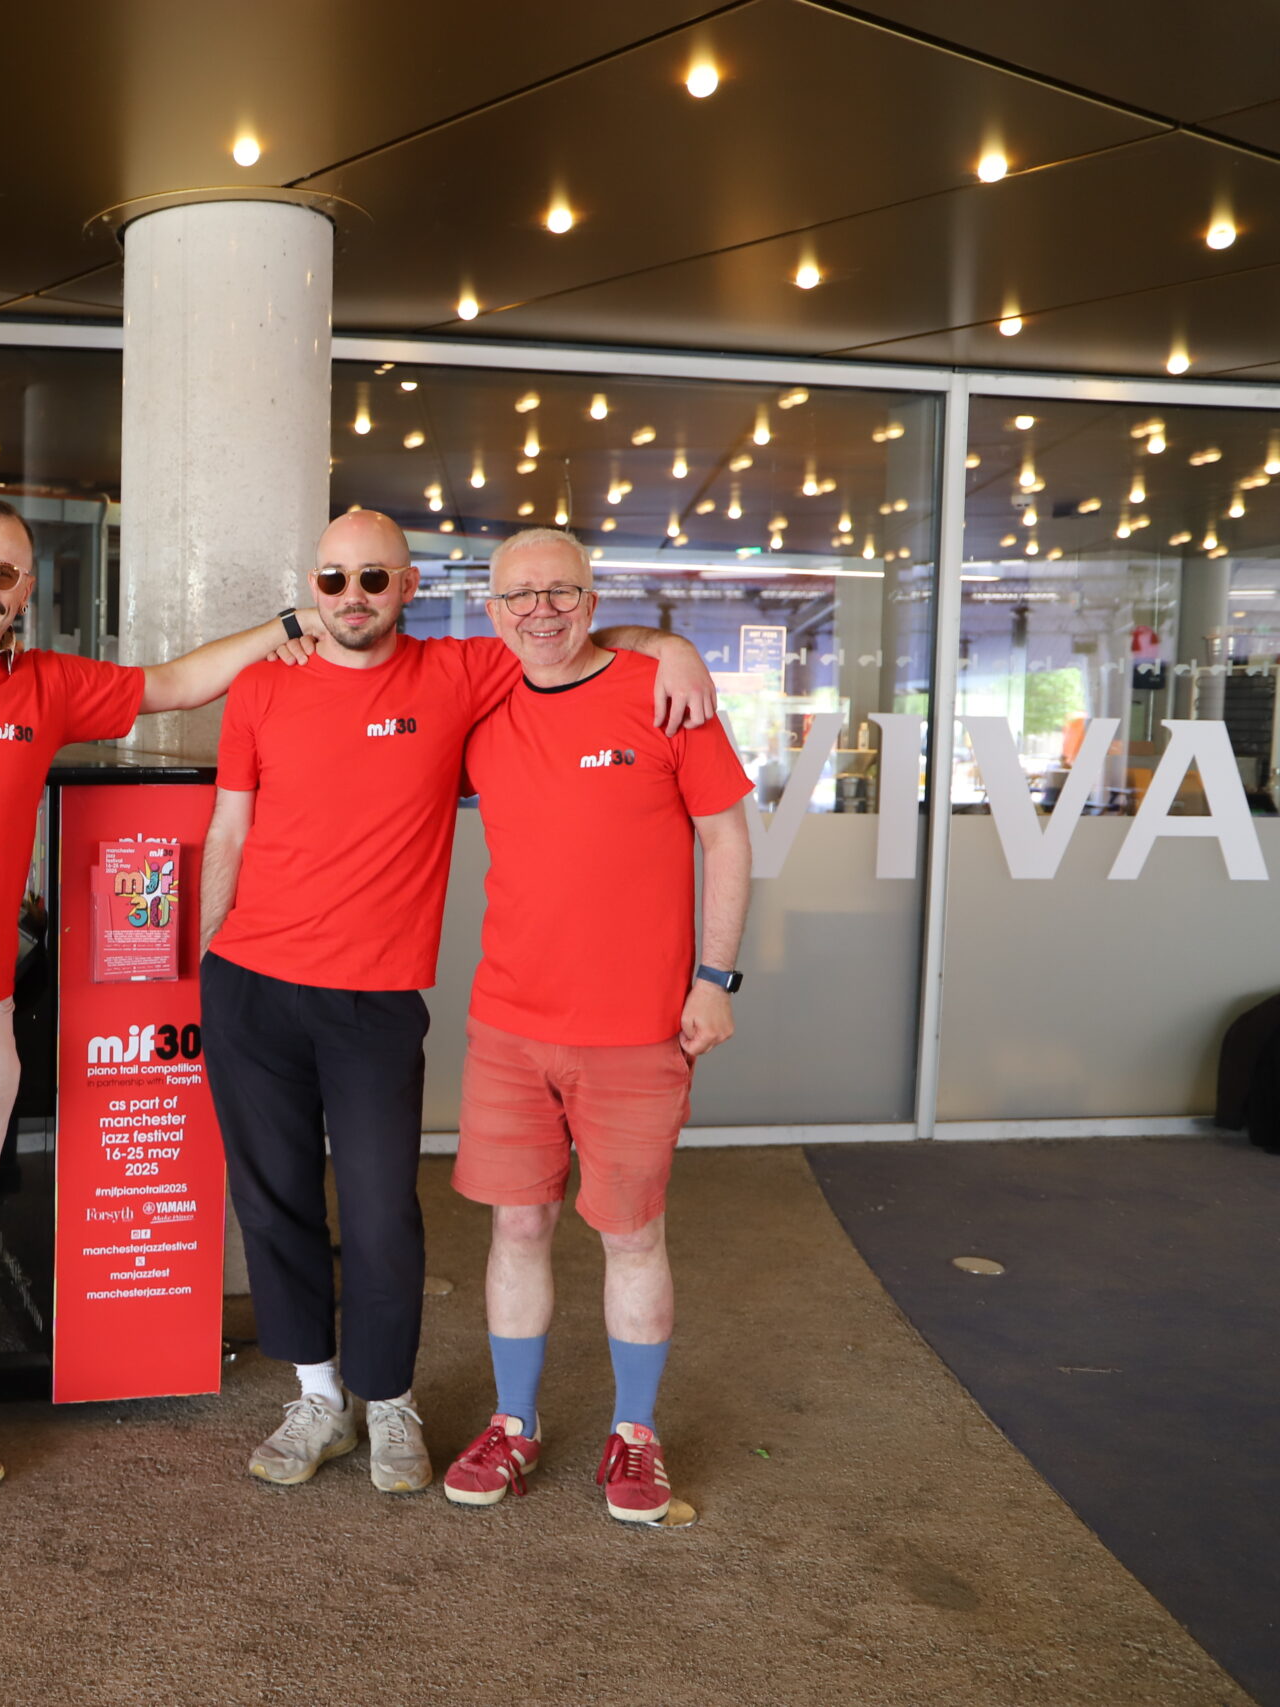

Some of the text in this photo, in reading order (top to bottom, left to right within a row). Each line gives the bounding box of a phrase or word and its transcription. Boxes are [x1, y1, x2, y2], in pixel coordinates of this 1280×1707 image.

[367, 718, 417, 737] mjf30
[580, 748, 635, 768] mjf30
[115, 860, 174, 895] mjf
[128, 895, 171, 927] 30
[87, 1023, 201, 1064] mjf30
[87, 1062, 202, 1078] piano trail competition
[96, 1077, 145, 1088] partnership
[146, 1077, 165, 1086] with
[166, 1075, 202, 1086] Forsyth
[109, 1096, 178, 1113] as part of
[99, 1113, 186, 1128] manchester
[101, 1129, 184, 1146] jazz festival
[105, 1147, 180, 1161] 16-25 may
[125, 1162, 159, 1176] 2025
[95, 1183, 188, 1198] #mjfpianotrail2025
[86, 1200, 197, 1223] Forsyth YAMAHA
[83, 1241, 197, 1256] manchesterjazzfestival
[110, 1268, 170, 1280] manjazzfest
[87, 1285, 192, 1300] manchesterjazz.com
